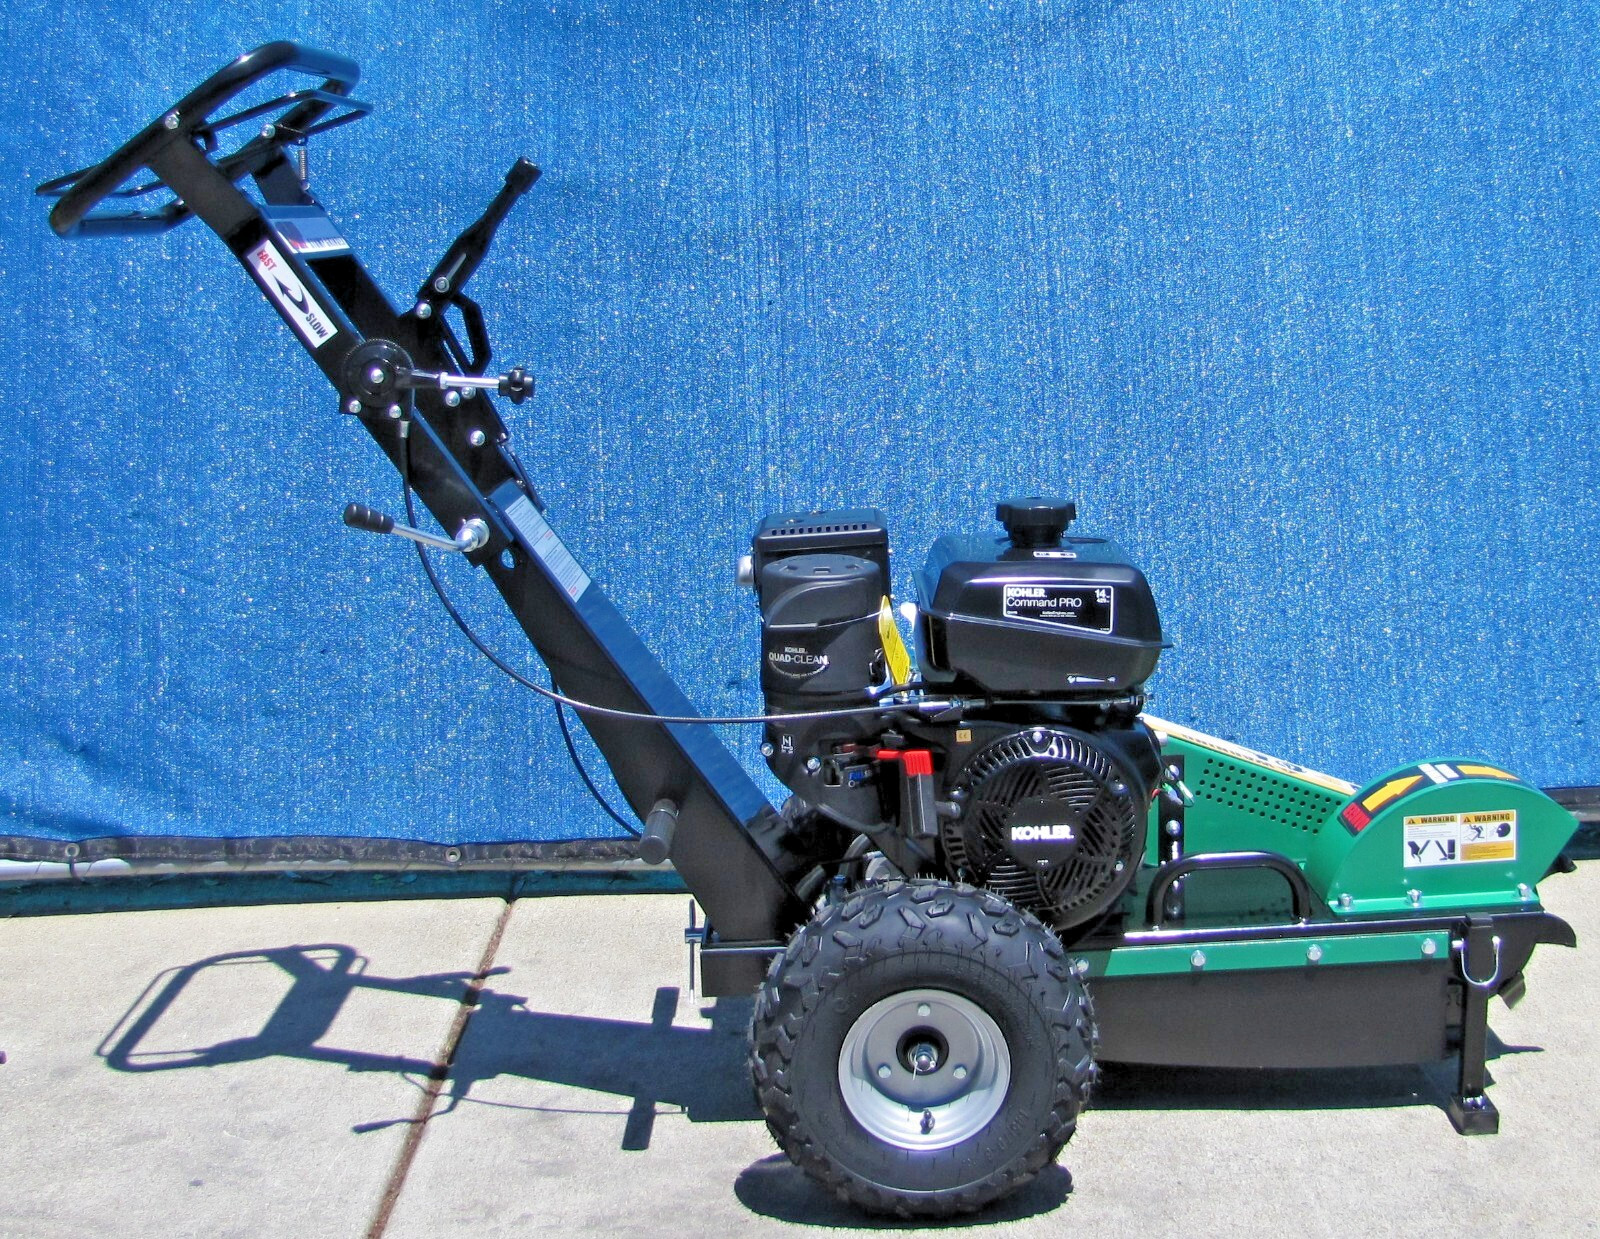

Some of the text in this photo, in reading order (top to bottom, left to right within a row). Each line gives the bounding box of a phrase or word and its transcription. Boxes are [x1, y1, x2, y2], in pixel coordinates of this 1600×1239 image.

[257, 250, 277, 271] FAST
[306, 313, 329, 339] SLOW
[1007, 588, 1047, 598] KOHLER
[1095, 589, 1106, 598] 14
[1006, 597, 1083, 608] Command PRO
[769, 652, 829, 665] QUAD-CLEAN
[1421, 815, 1455, 824] WARNING
[1474, 813, 1511, 823] WARNING
[1012, 825, 1074, 840] KOHLER
